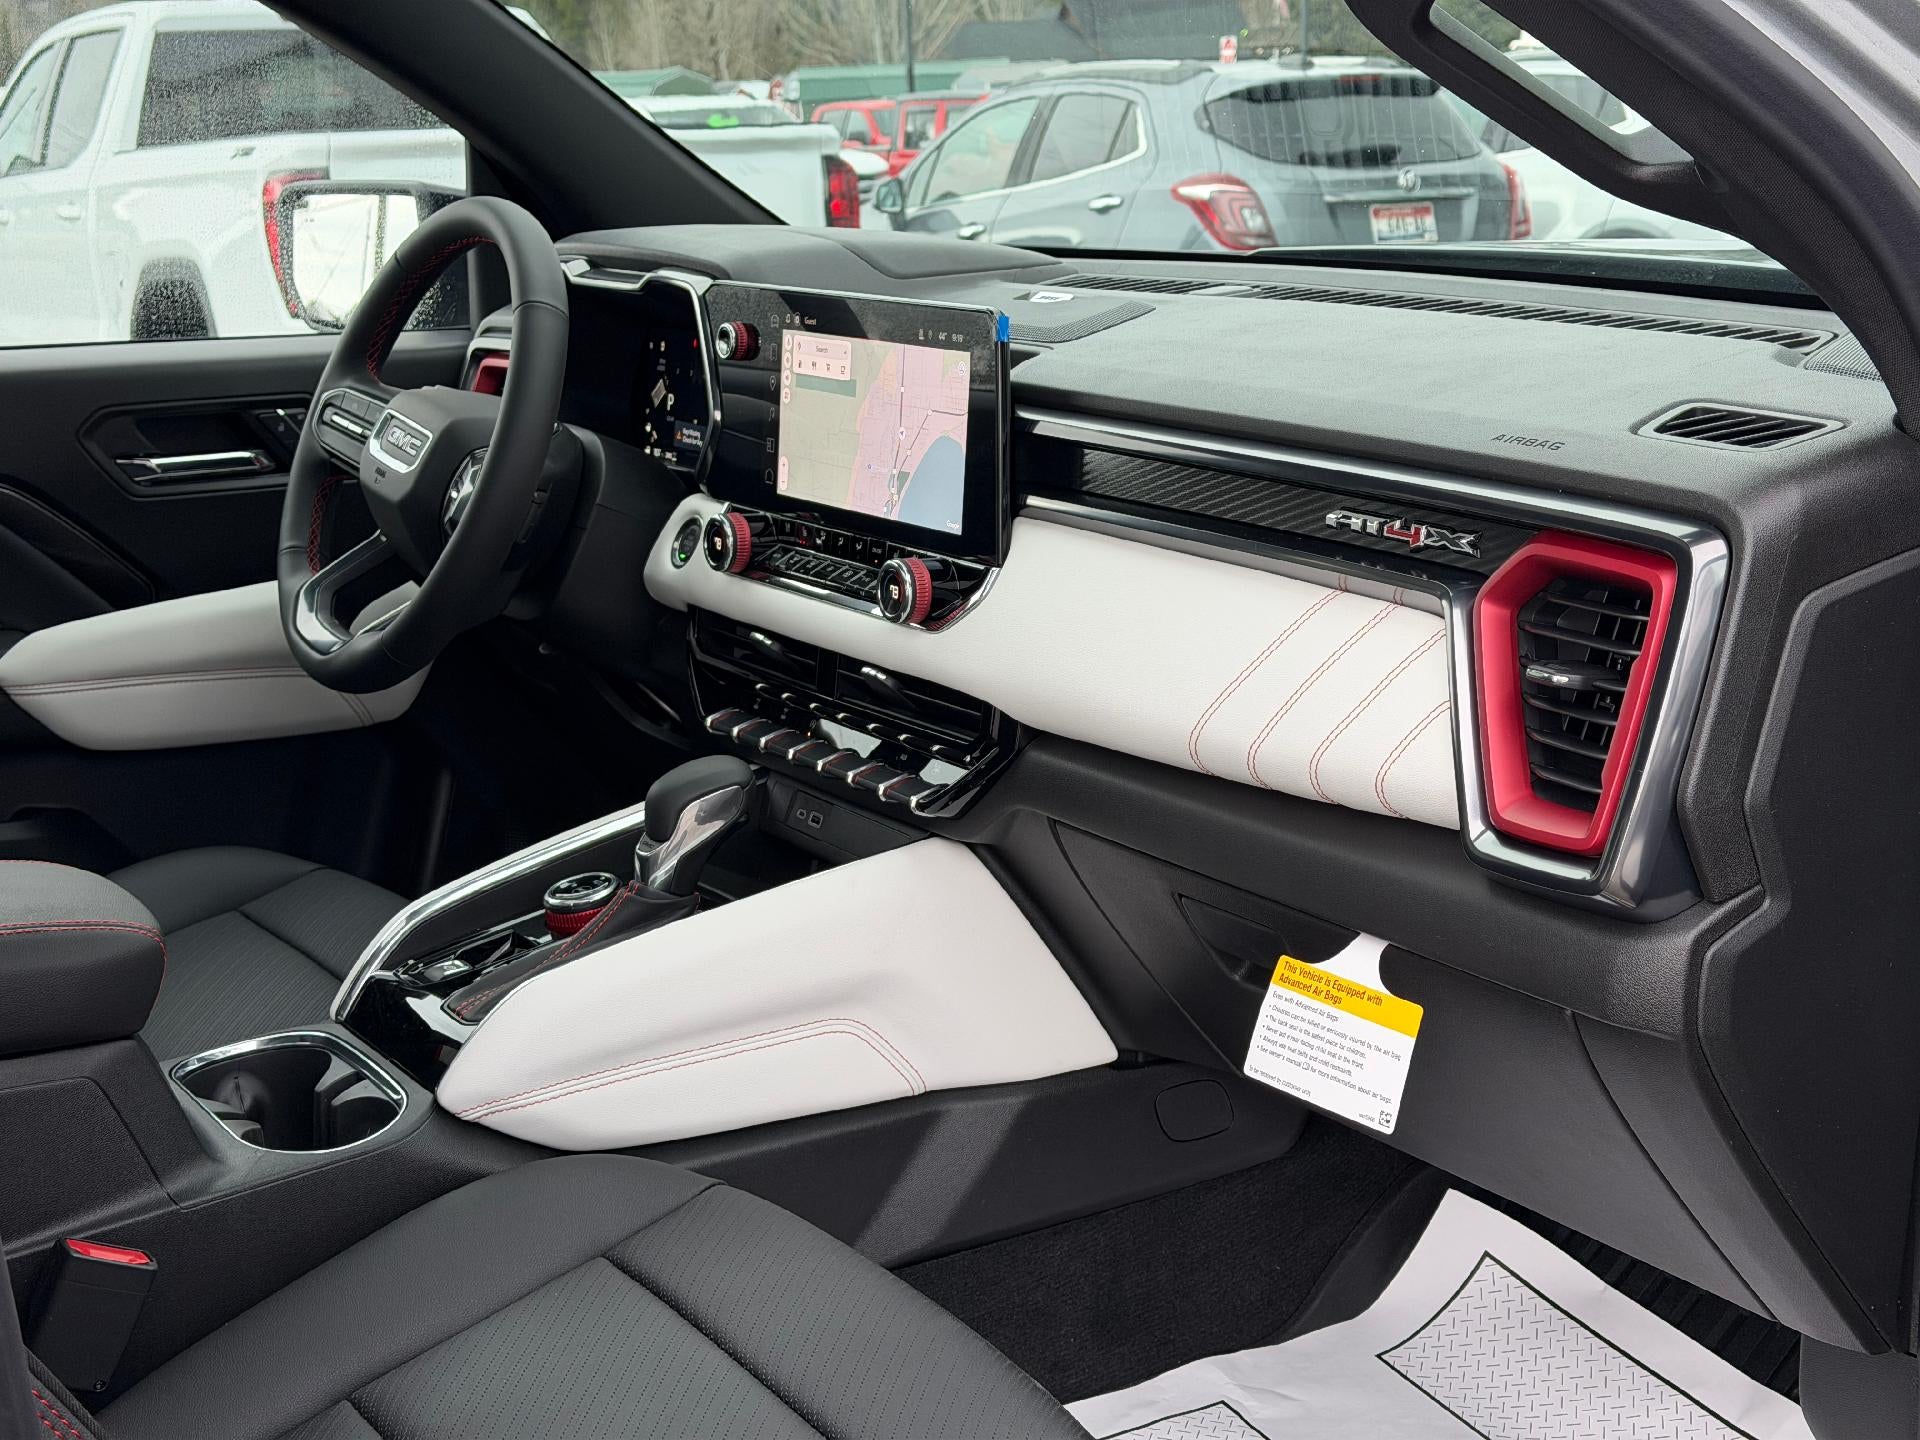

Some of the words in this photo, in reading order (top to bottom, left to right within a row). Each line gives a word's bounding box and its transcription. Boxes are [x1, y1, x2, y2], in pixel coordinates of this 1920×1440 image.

[804, 316, 816, 326] Guest
[666, 393, 675, 411] P
[387, 424, 423, 456] GMC
[1491, 433, 1566, 451] AIRBAG
[1325, 510, 1482, 558] AT4X
[1278, 973, 1313, 993] Advanced
[1312, 985, 1323, 997] Air
[1324, 989, 1342, 1005] Bags
[1283, 960, 1298, 974] This
[1299, 966, 1324, 984] Vehicle
[1324, 976, 1332, 987] is
[1332, 979, 1366, 1000] Equipped
[1366, 994, 1383, 1006] with
